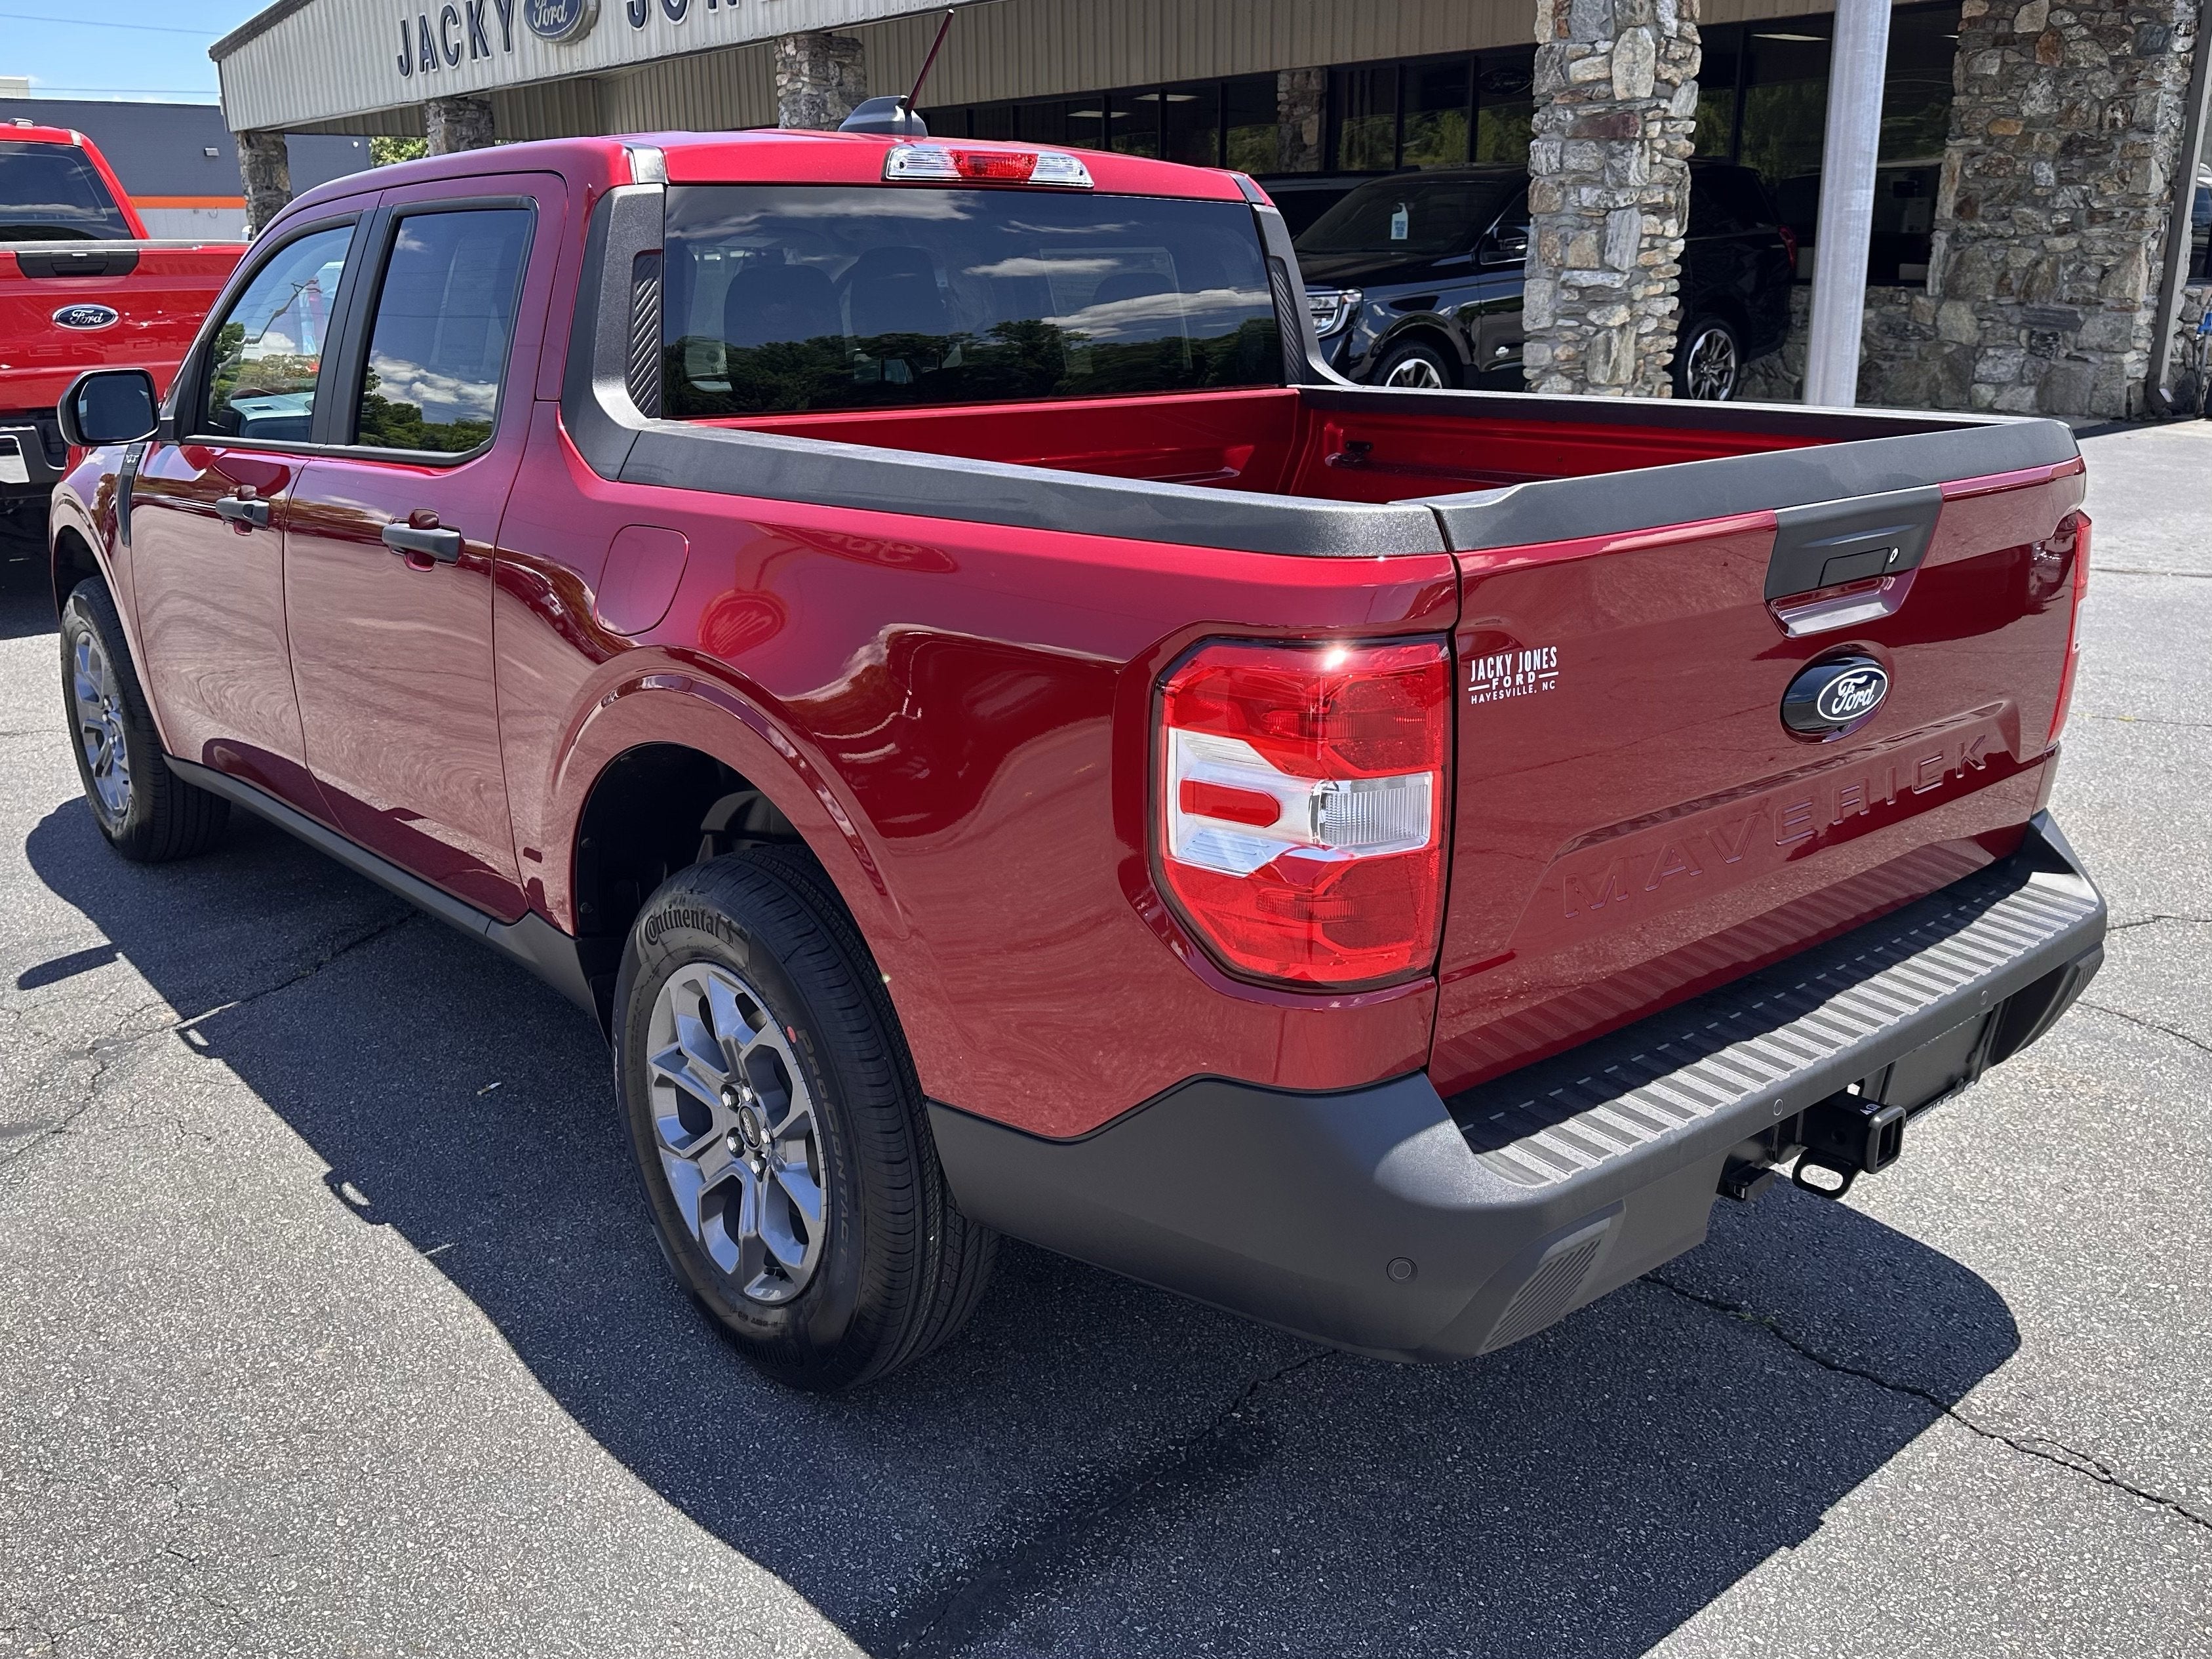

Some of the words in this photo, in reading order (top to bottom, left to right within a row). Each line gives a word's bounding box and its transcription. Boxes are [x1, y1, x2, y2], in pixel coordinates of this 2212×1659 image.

[532, 0, 568, 29] Ford
[397, 0, 515, 79] JACKY
[69, 309, 104, 325] Ford
[1471, 654, 1512, 682] JACKY
[1518, 646, 1557, 673] JONES
[1491, 671, 1535, 690] FORD
[1471, 683, 1537, 705] HAYESVILLE,
[1542, 679, 1556, 691] NC
[1831, 675, 1875, 715] Ford
[1562, 734, 1988, 919] MAVERICK
[644, 904, 722, 946] Continental
